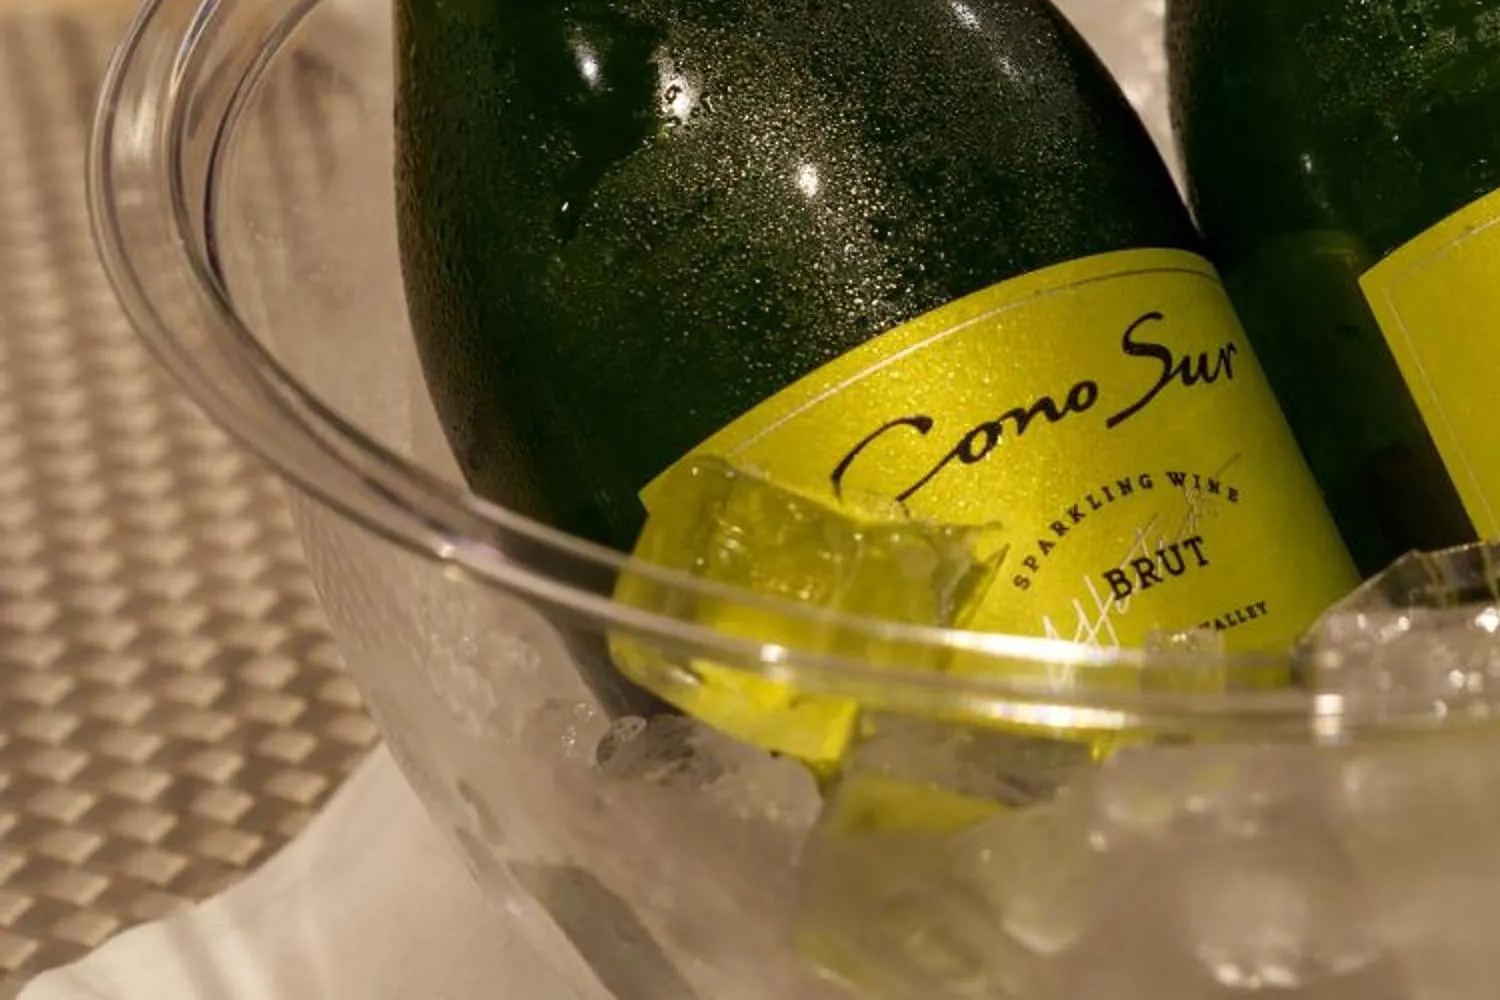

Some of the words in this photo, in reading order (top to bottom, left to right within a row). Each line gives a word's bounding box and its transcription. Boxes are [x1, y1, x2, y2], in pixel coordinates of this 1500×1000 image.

[831, 379, 1099, 502] Cono
[1106, 311, 1238, 428] Sur
[1013, 472, 1154, 591] SPARKLING
[1165, 470, 1240, 503] WINE
[1103, 535, 1209, 602] BRUT
